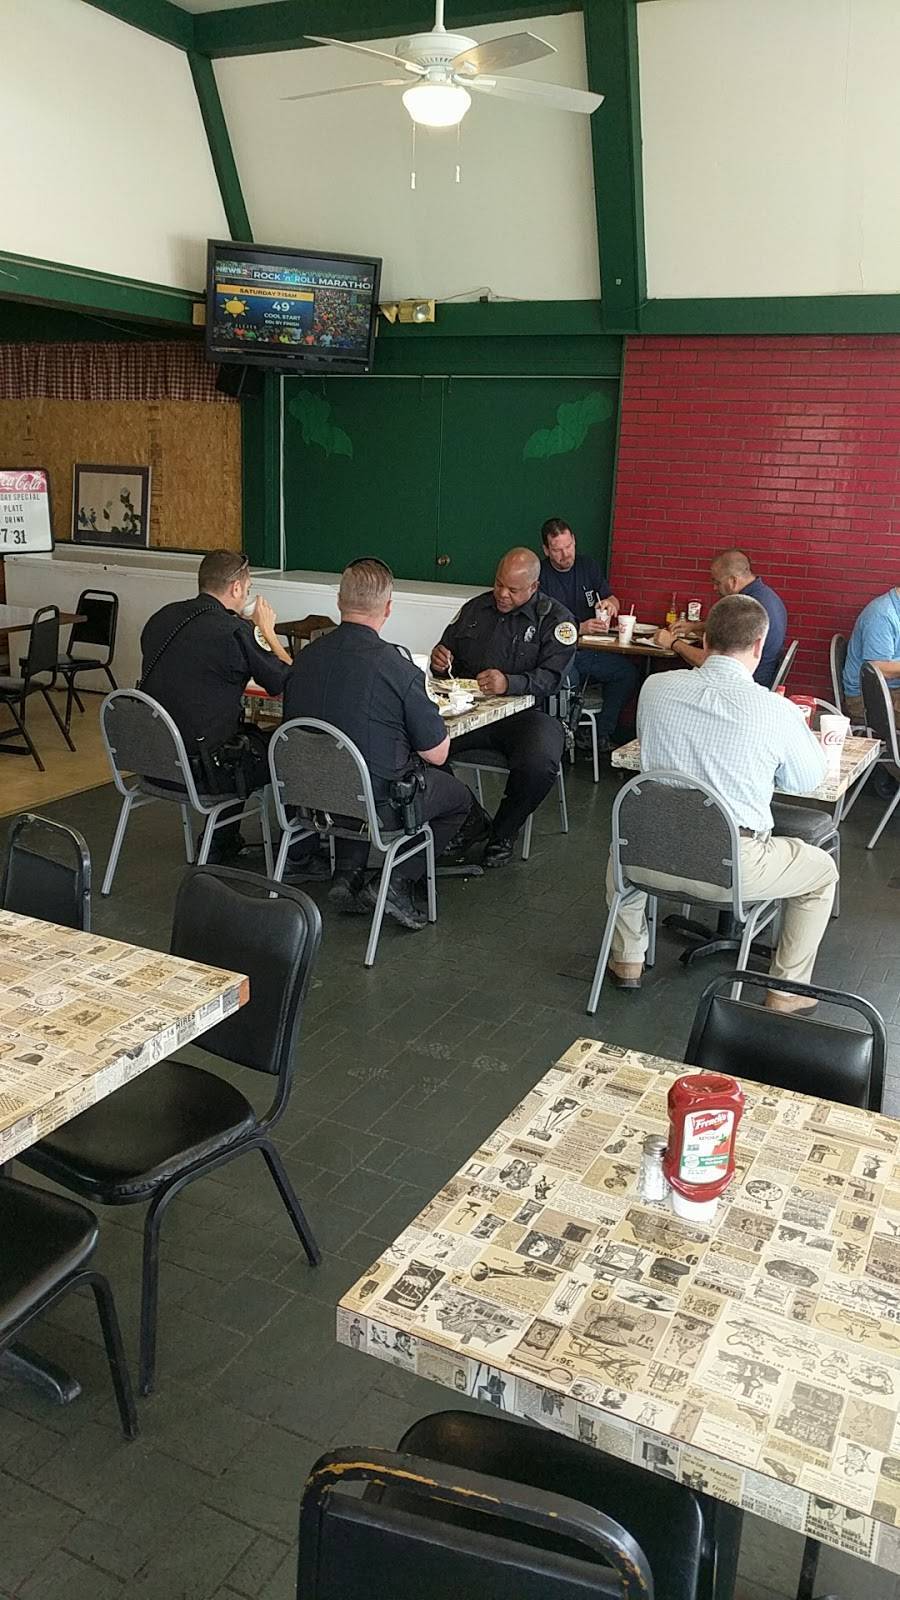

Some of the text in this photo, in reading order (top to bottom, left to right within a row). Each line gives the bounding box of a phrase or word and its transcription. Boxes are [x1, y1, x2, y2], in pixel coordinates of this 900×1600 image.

[253, 271, 281, 281] ROCK
[295, 275, 317, 285] ROLL
[319, 278, 374, 290] MARATHO
[239, 287, 276, 297] SATURDAY
[263, 312, 281, 320] COOL
[13, 493, 41, 501] SPECIAL
[4, 504, 24, 513] PLATE
[4, 515, 25, 524] DRINK
